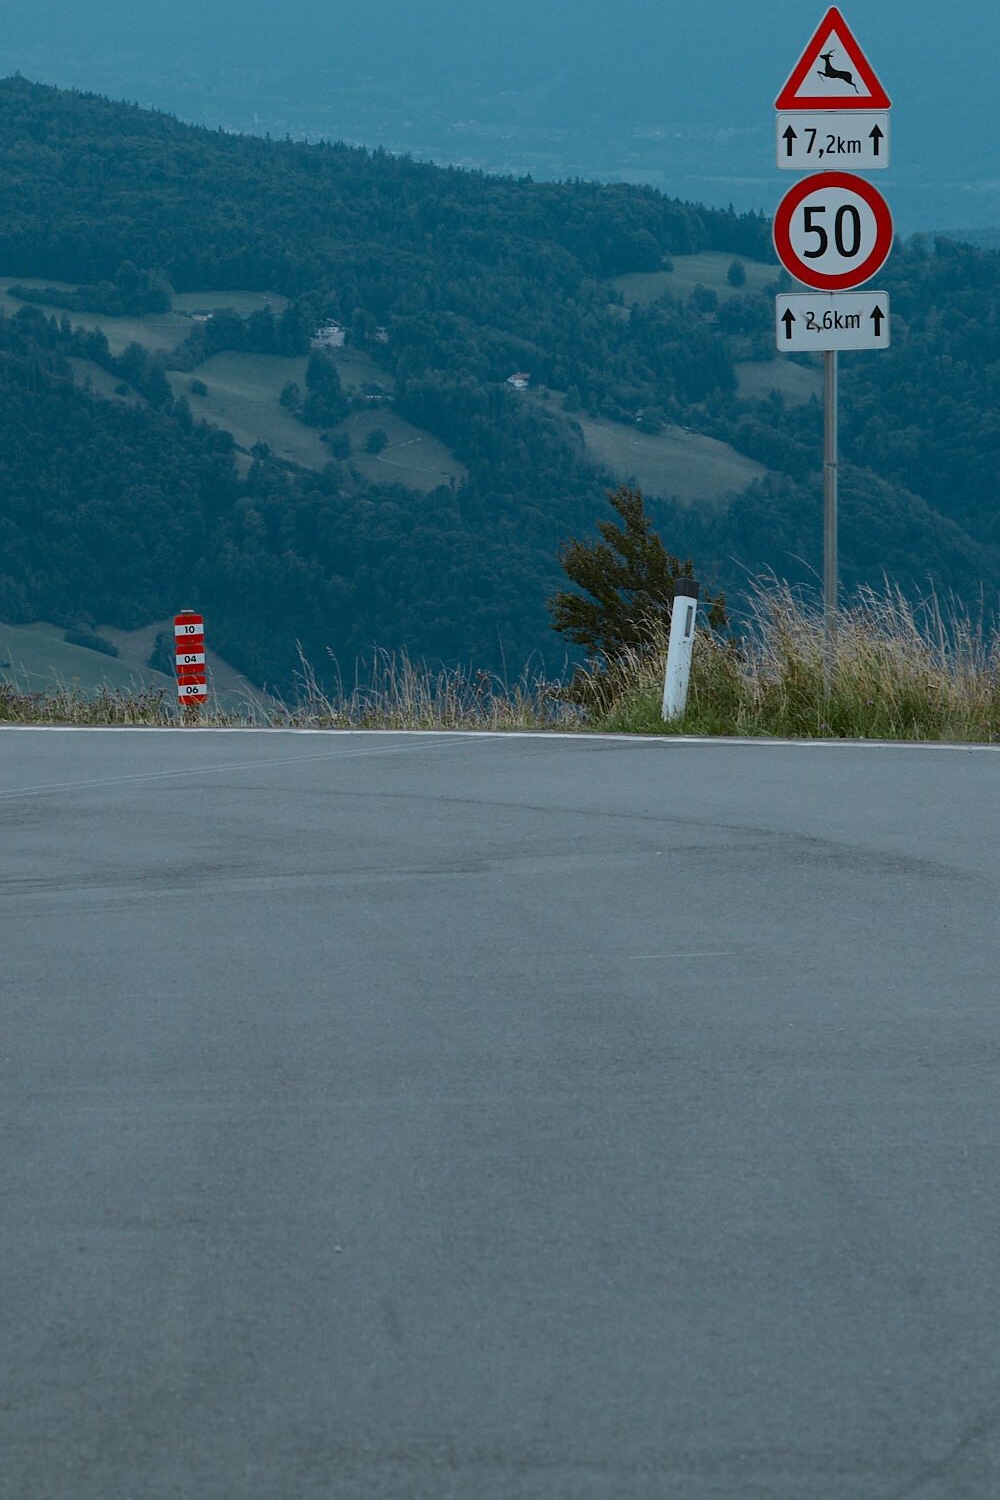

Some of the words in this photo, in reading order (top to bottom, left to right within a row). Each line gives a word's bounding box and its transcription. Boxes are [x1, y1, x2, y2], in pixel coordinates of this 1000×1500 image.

[804, 128, 862, 159] 7,2km
[803, 204, 861, 258] 50
[806, 311, 860, 333] 2,6km
[184, 625, 195, 634] 10
[184, 655, 197, 664] 04
[186, 686, 199, 694] 06
